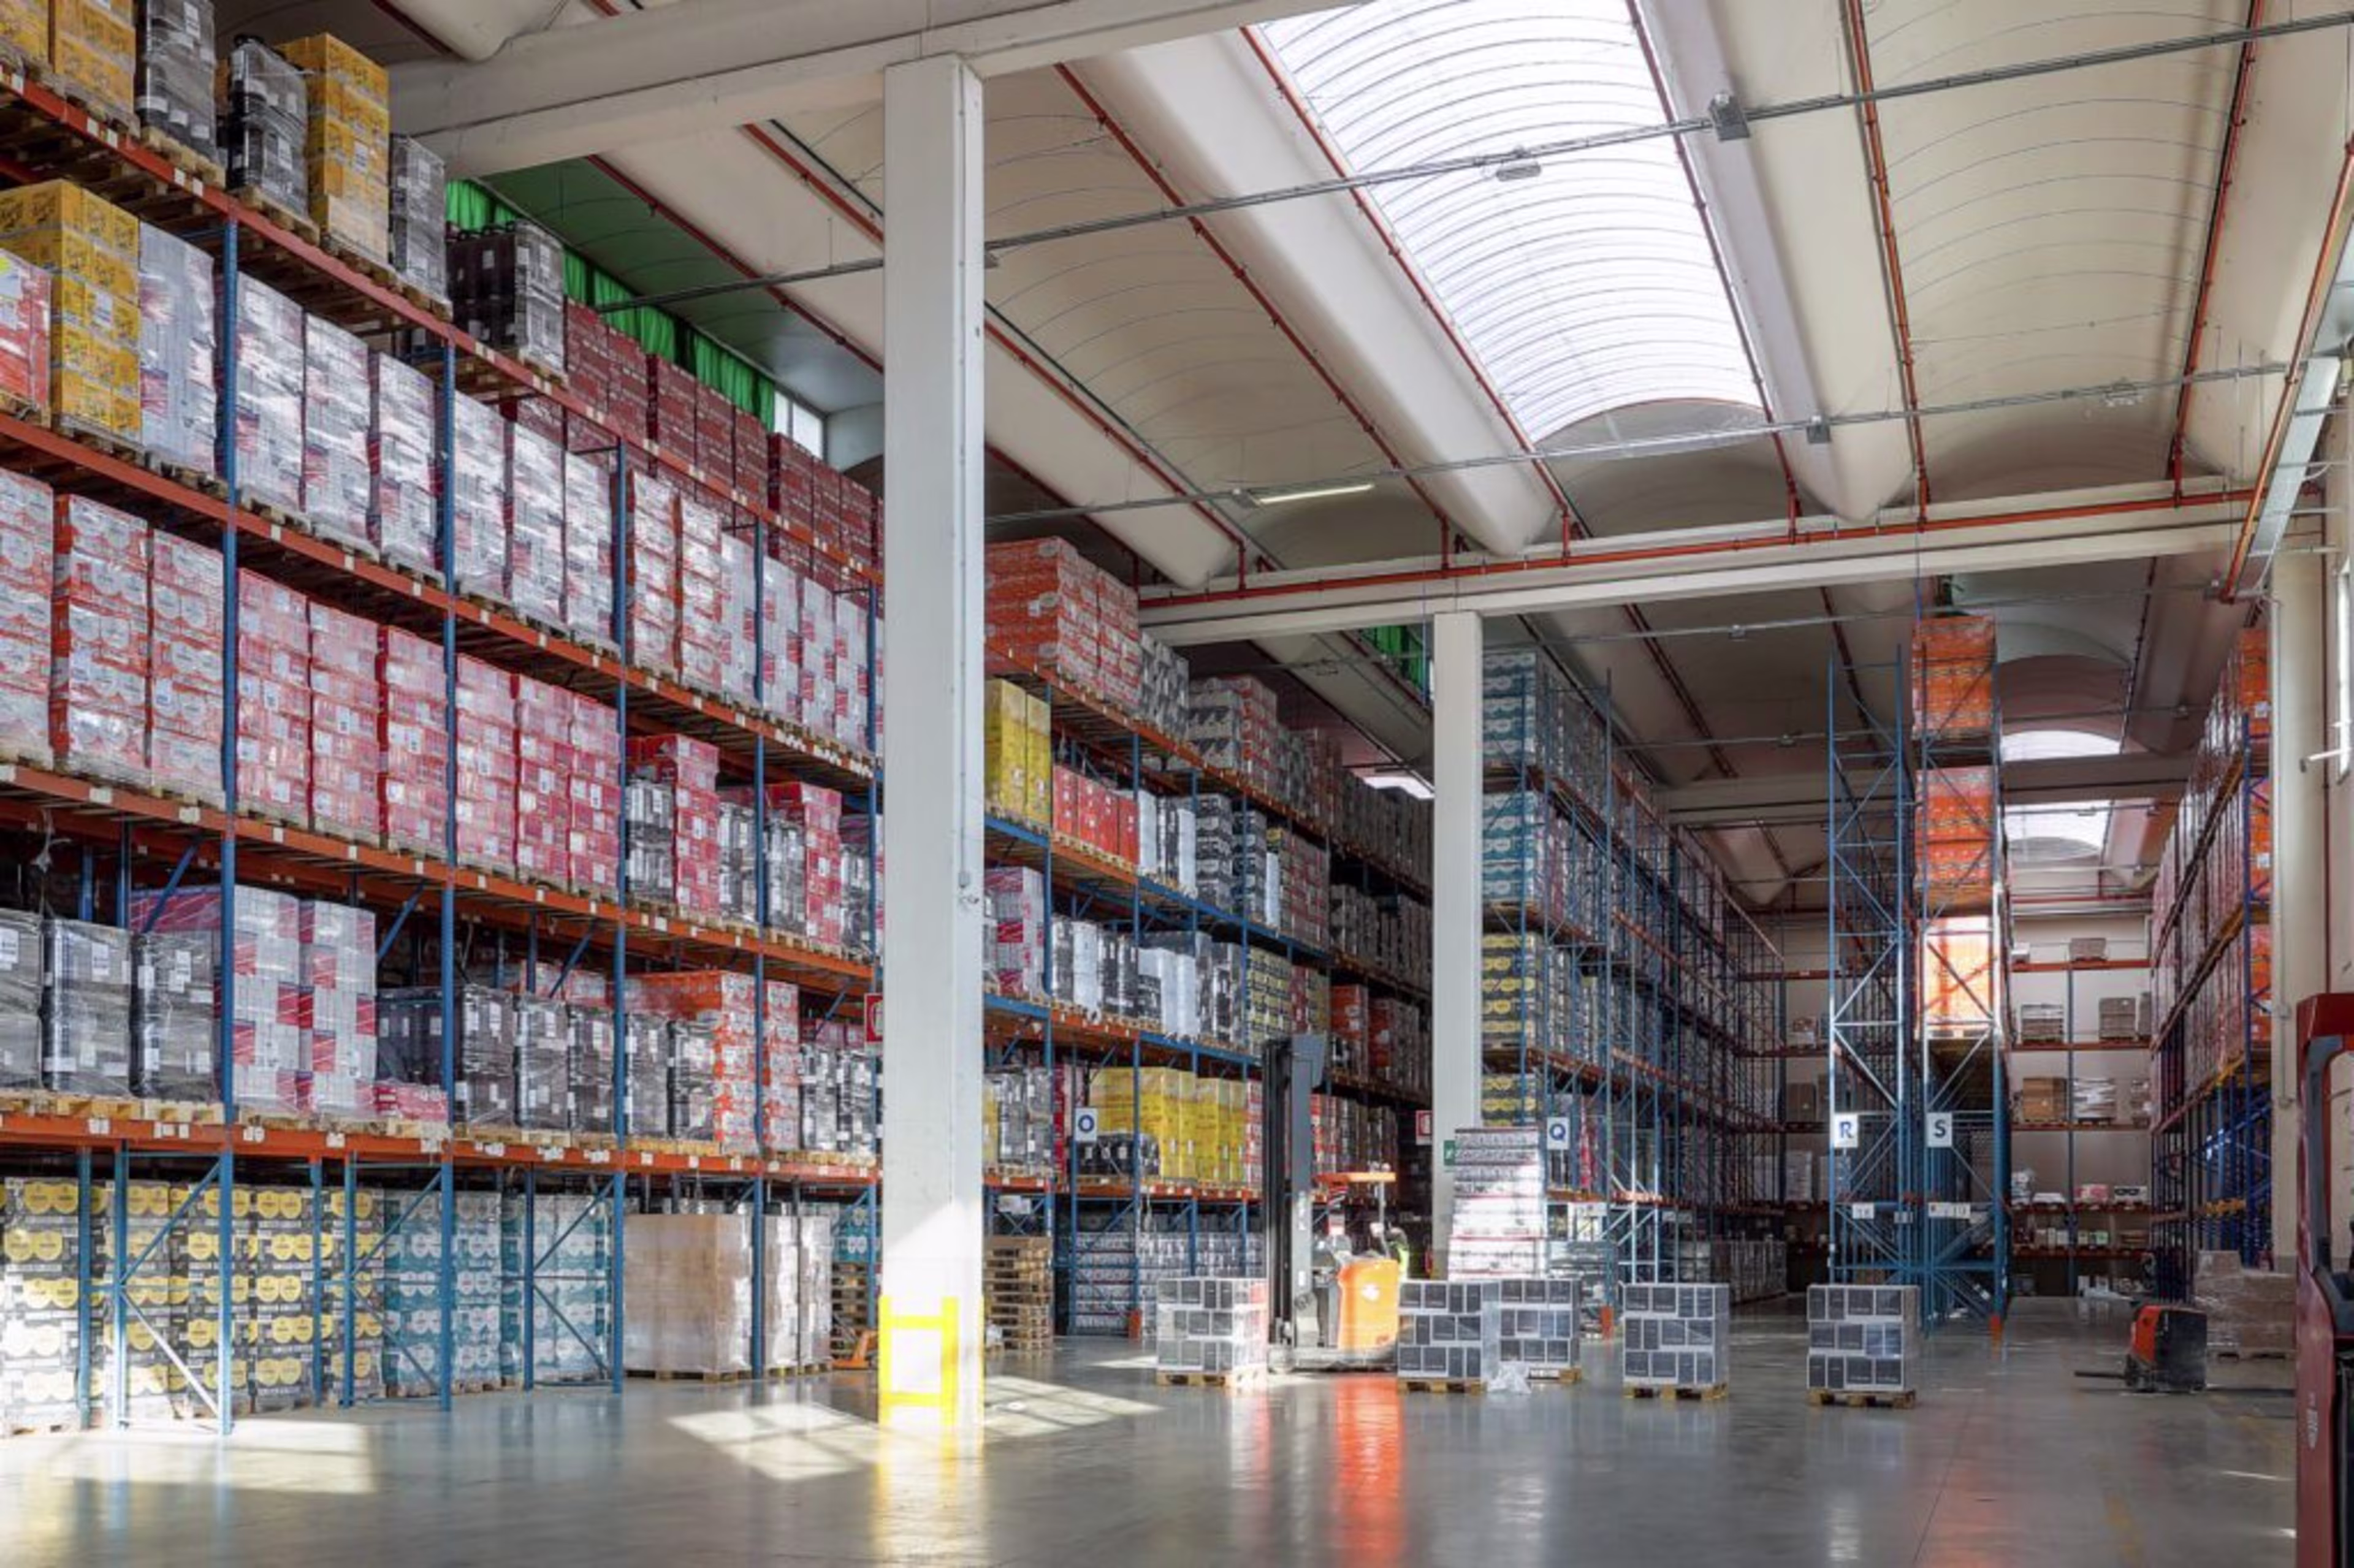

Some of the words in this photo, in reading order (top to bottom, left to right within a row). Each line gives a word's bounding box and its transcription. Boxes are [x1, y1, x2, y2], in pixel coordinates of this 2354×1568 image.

[1078, 1114, 1095, 1134] O
[1549, 1124, 1566, 1142] Q
[1840, 1121, 1854, 1139] R
[1933, 1119, 1946, 1139] S
